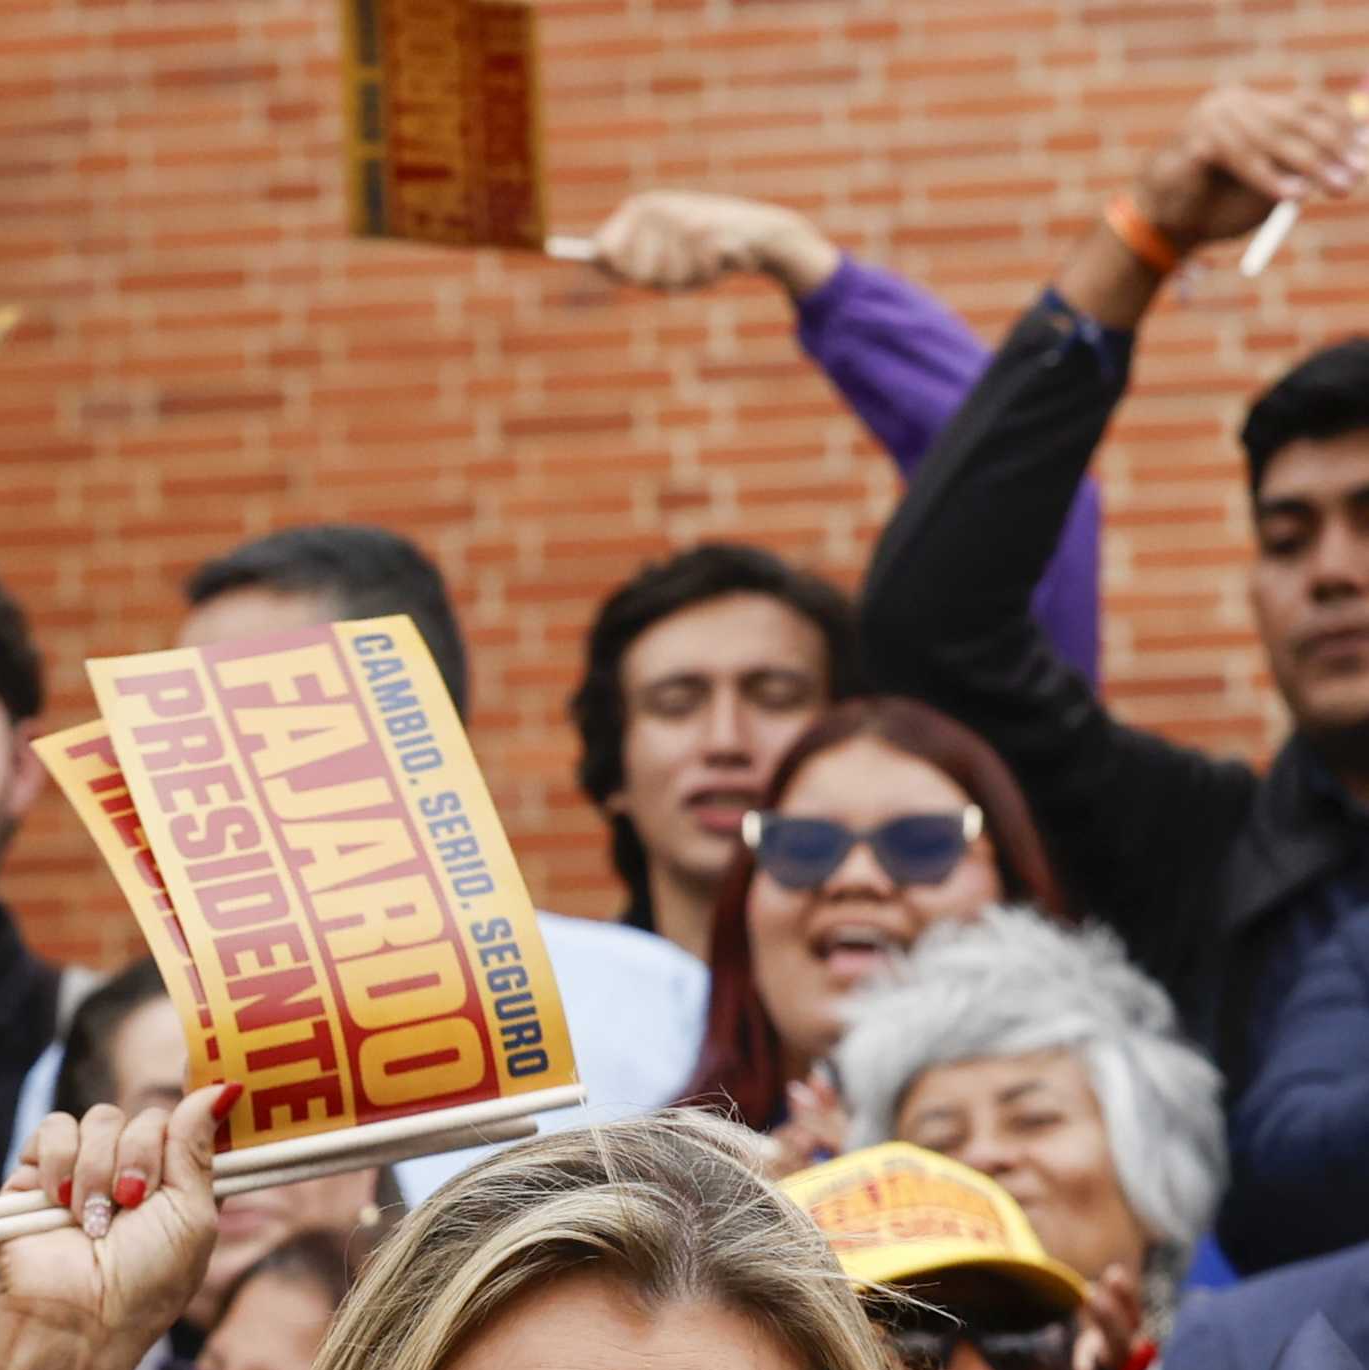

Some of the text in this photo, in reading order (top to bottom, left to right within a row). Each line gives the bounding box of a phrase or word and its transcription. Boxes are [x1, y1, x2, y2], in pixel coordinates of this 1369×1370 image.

[113, 667, 346, 1132] PRESIDENTE
[214, 642, 485, 1107] FAJARDO
[352, 632, 550, 1079] CAMBIO. SERIO. SEGURO
